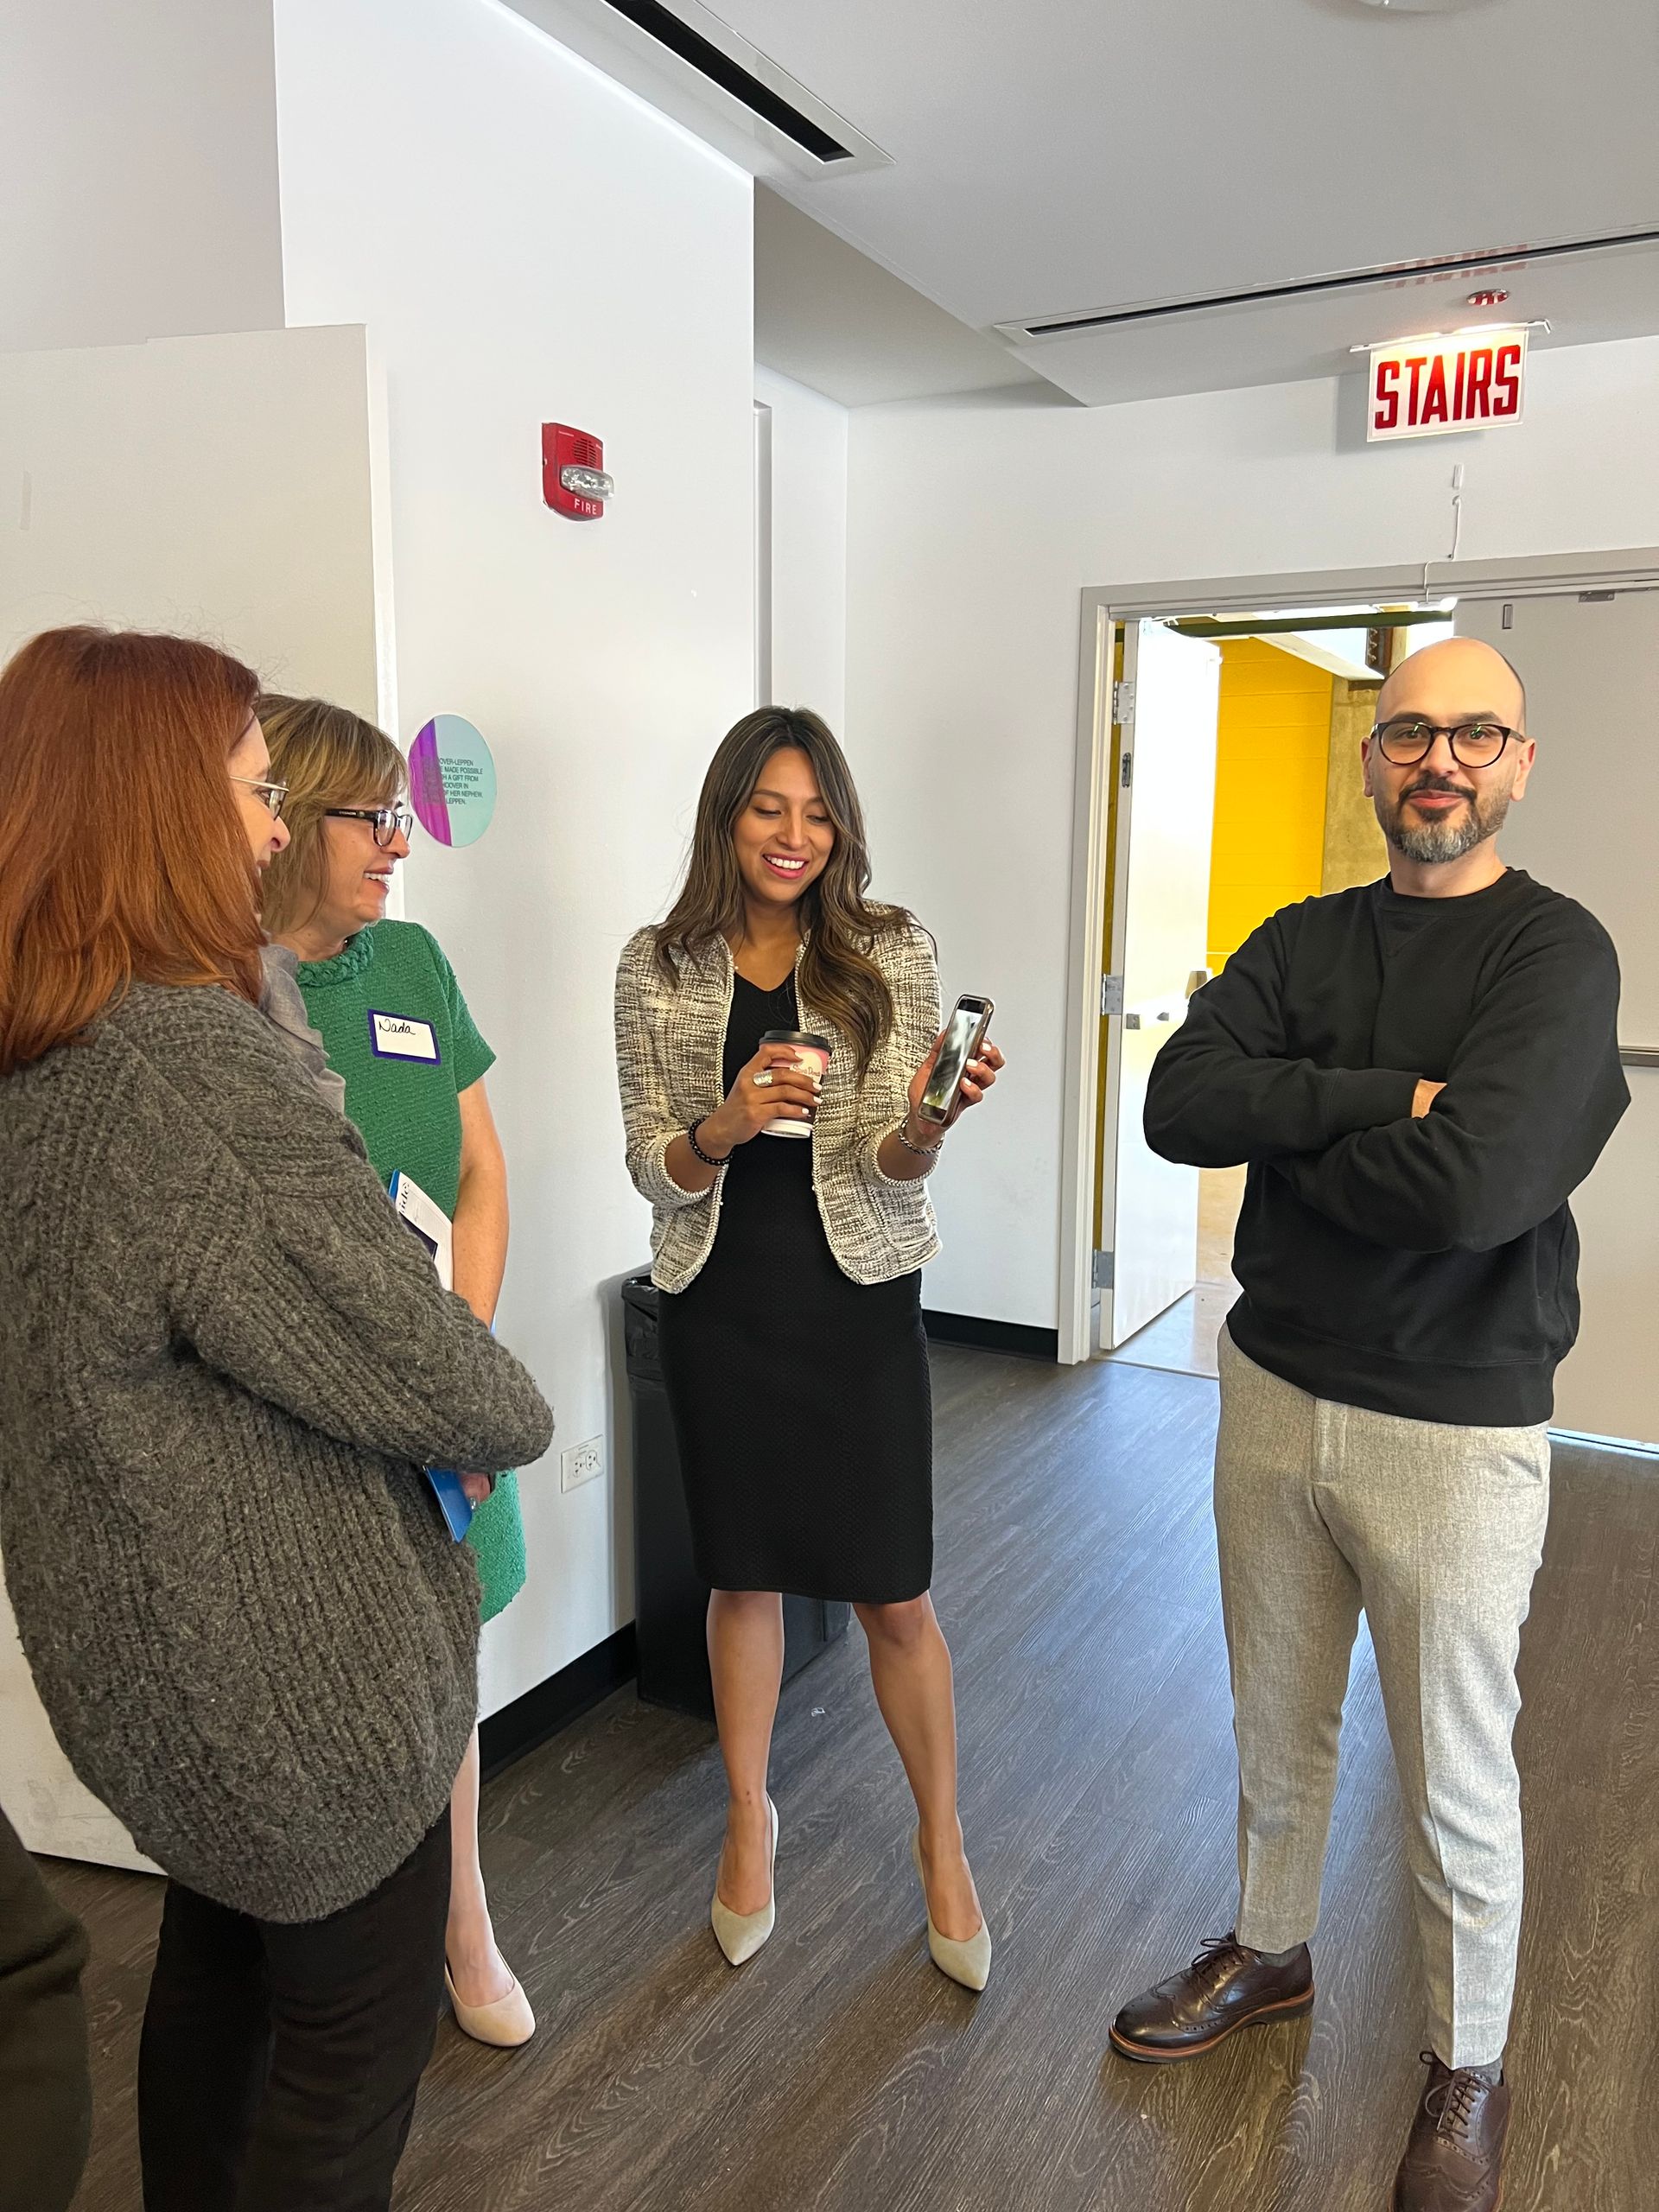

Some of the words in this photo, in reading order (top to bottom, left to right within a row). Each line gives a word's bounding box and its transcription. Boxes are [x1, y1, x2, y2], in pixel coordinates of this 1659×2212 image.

[1375, 344, 1521, 429] STAIRS
[575, 498, 597, 515] FIRE
[440, 757, 474, 766] OVER-LEPPEN
[460, 766, 483, 775] POSSIBLE
[378, 1018, 416, 1035] Nada
